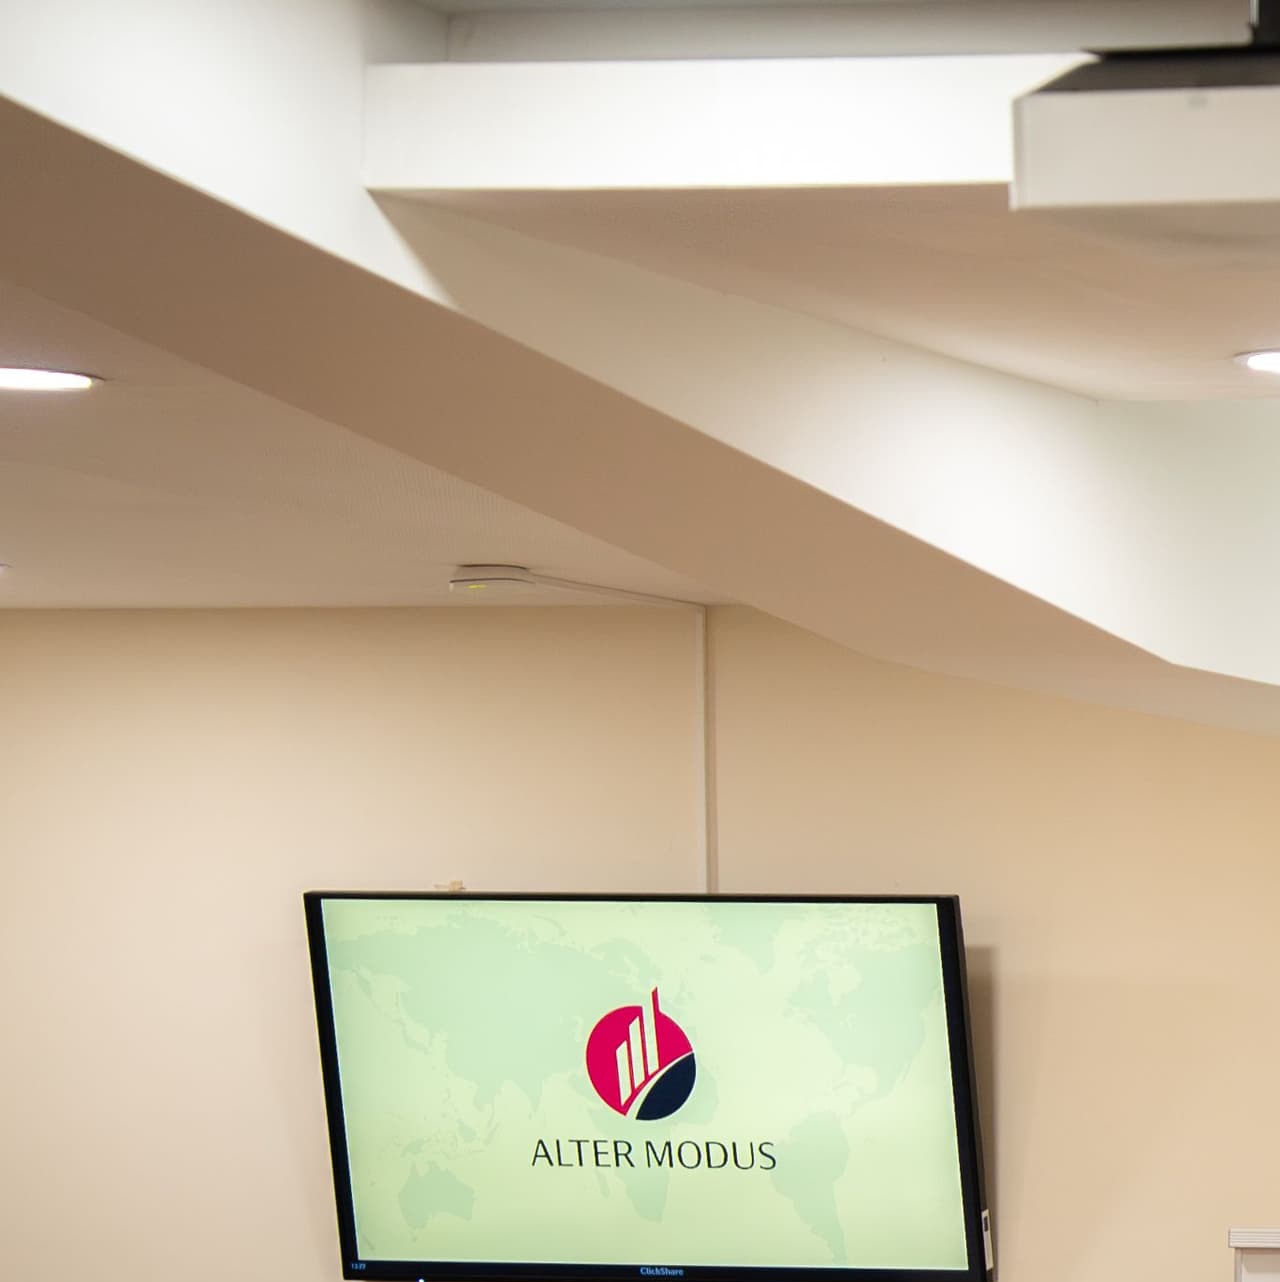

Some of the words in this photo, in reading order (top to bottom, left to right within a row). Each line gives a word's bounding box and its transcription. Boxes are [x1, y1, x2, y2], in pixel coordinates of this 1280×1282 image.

[530, 1138, 635, 1169] ALTER
[645, 1139, 778, 1172] MODUS
[640, 1266, 684, 1277] ClickShare
